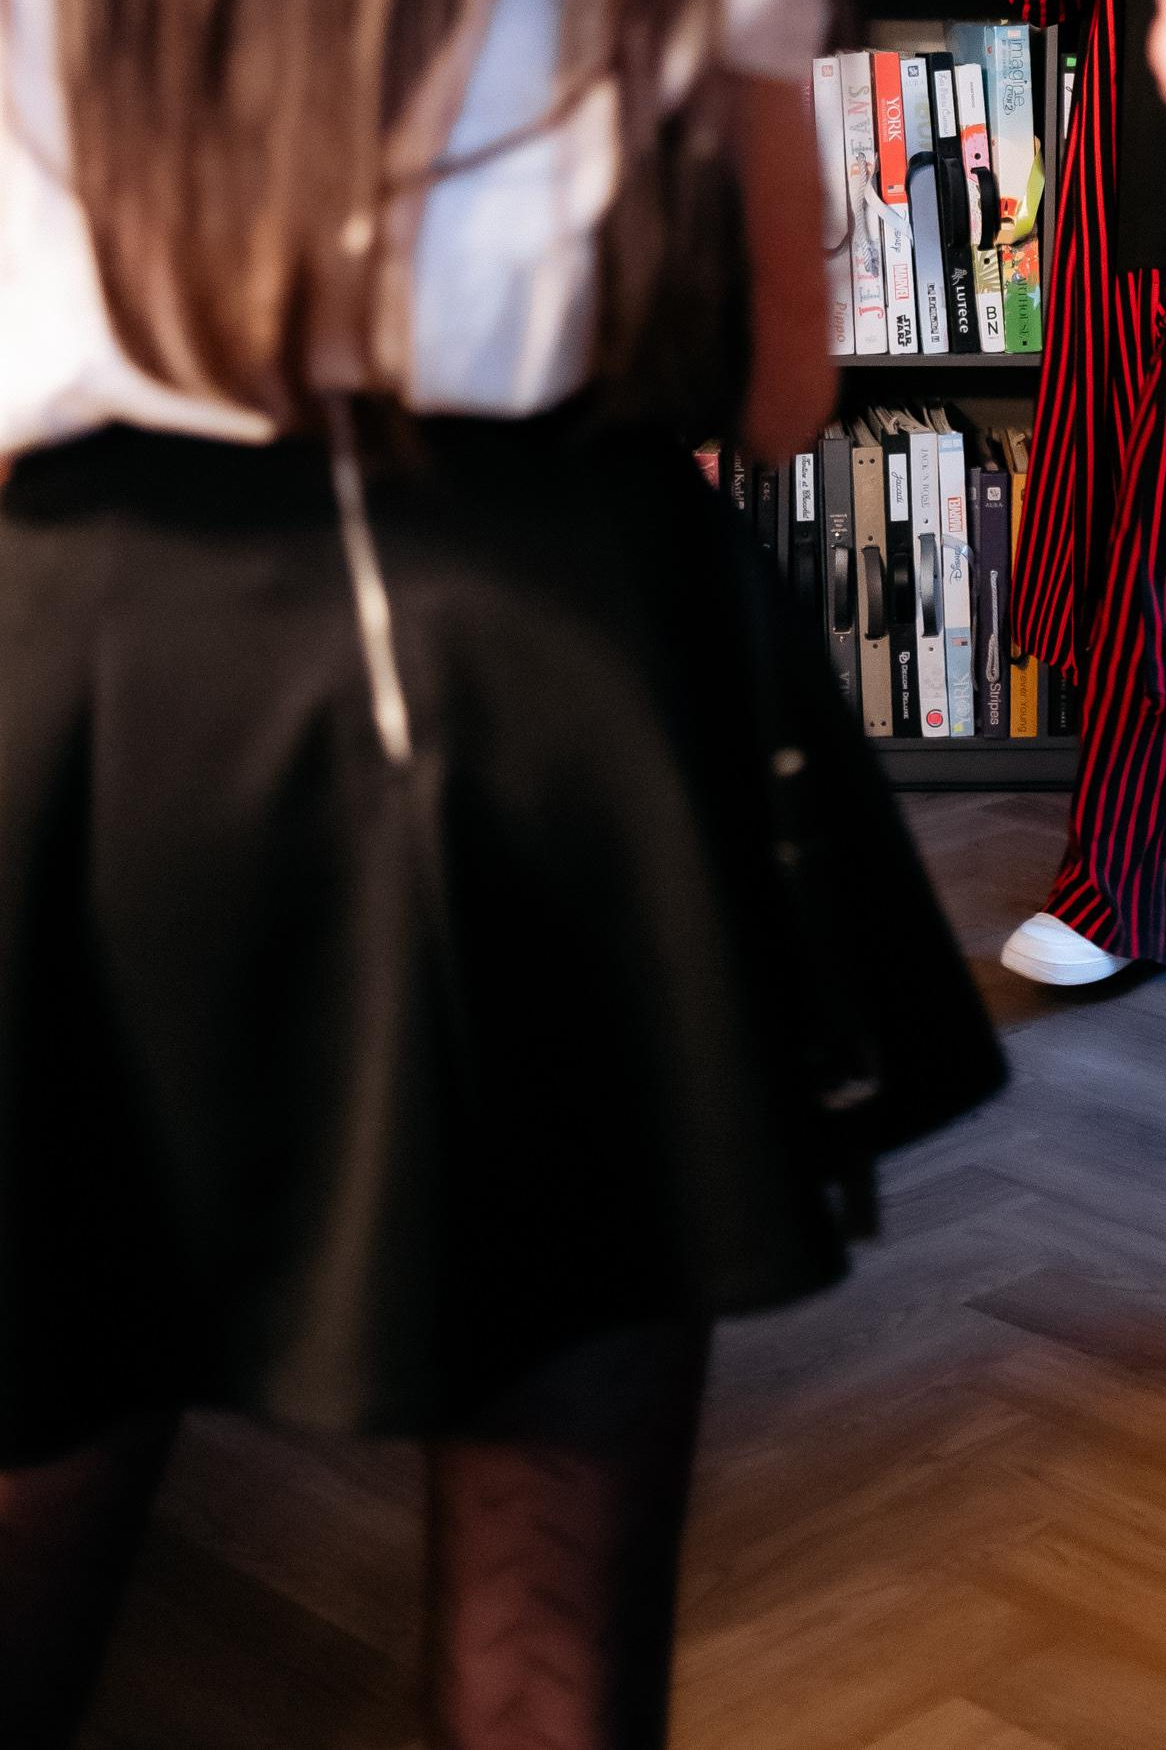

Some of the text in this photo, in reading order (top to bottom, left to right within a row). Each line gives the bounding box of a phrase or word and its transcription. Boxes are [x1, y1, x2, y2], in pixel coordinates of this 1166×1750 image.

[886, 96, 902, 141] YORK
[893, 264, 909, 300] MARVEL
[834, 302, 847, 342] Pippo
[896, 315, 905, 347] WARS
[903, 315, 912, 347] STAR
[948, 497, 962, 532] MARVEL
[952, 672, 970, 724] YORK
[988, 682, 1001, 725] Stripes
